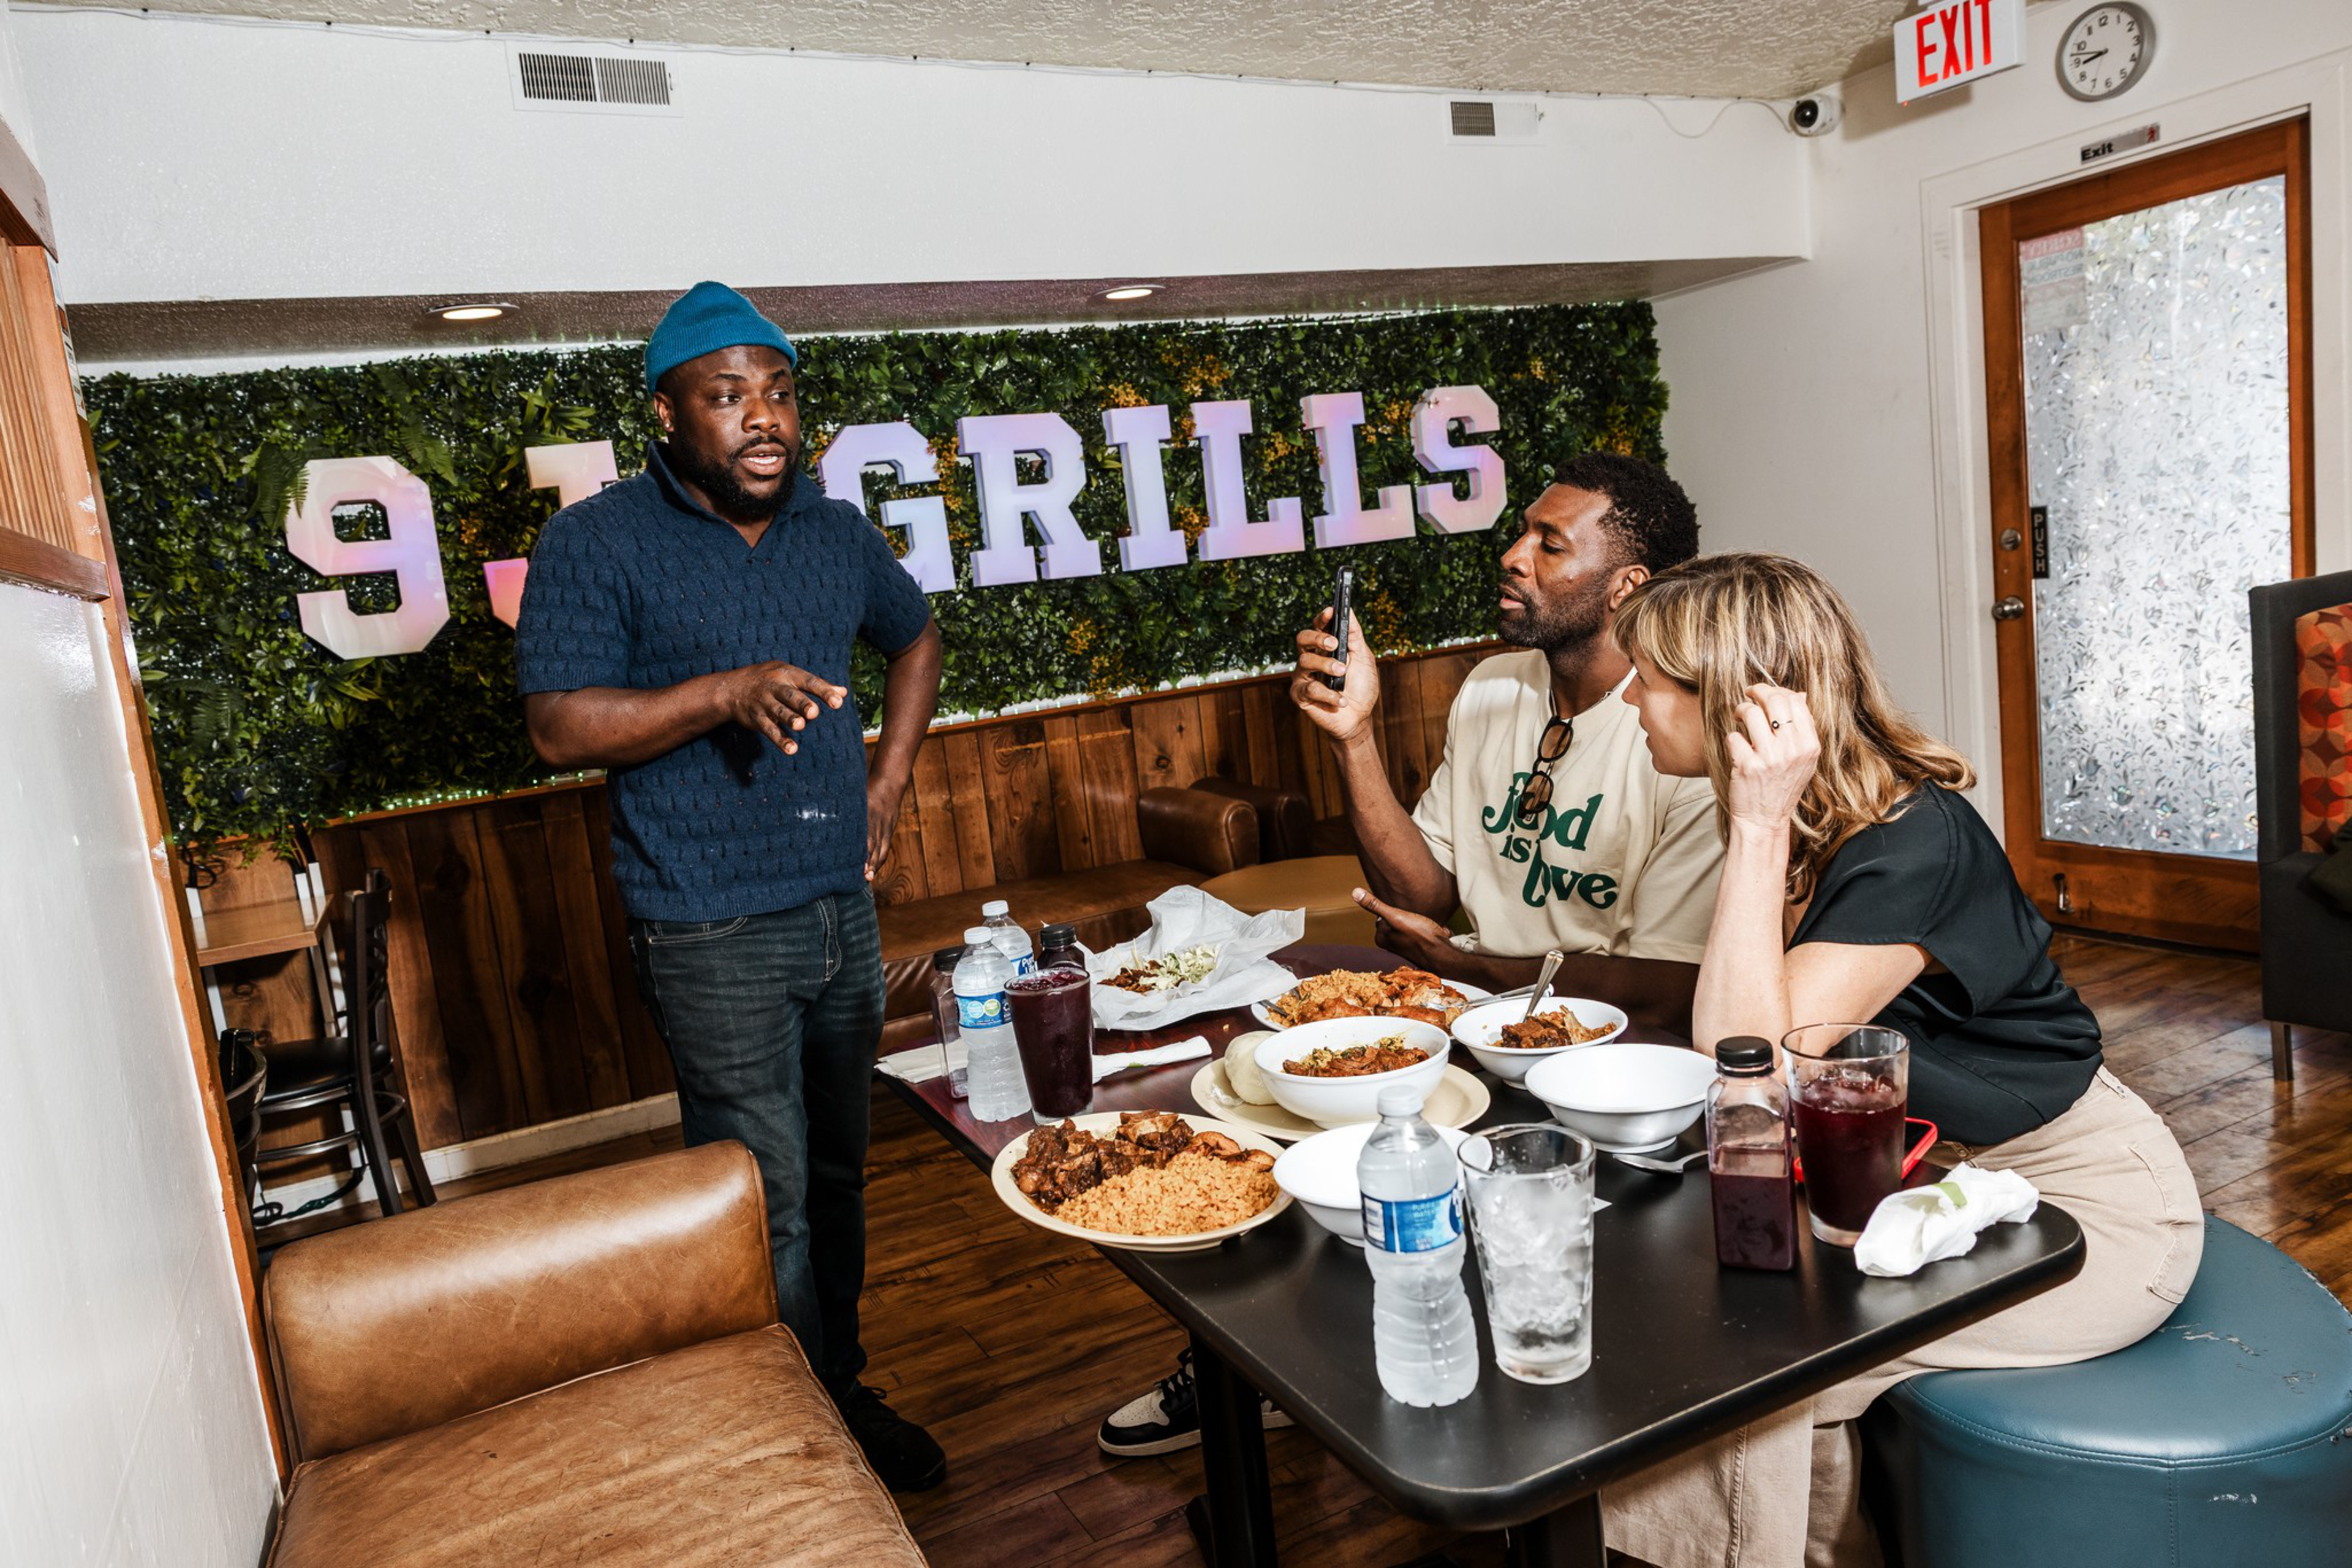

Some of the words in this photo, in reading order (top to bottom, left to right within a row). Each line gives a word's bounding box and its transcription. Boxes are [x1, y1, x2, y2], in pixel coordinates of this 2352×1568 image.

[2098, 15, 2109, 28] 12
[2116, 13, 2121, 24] 1
[2127, 20, 2136, 32] 2
[1916, 0, 1992, 88] EXIT
[2076, 40, 2087, 51] 10
[2132, 35, 2141, 47] 3
[2073, 57, 2081, 68] 9
[2129, 53, 2137, 62] 4
[2079, 71, 2087, 82] 8
[2119, 67, 2128, 80] 5
[2090, 78, 2097, 89] 7
[2104, 77, 2112, 88] 6
[2081, 141, 2113, 161] Exit
[818, 385, 1508, 594] GRILLS
[2034, 514, 2045, 572] PUSH
[1499, 823, 1532, 863] is
